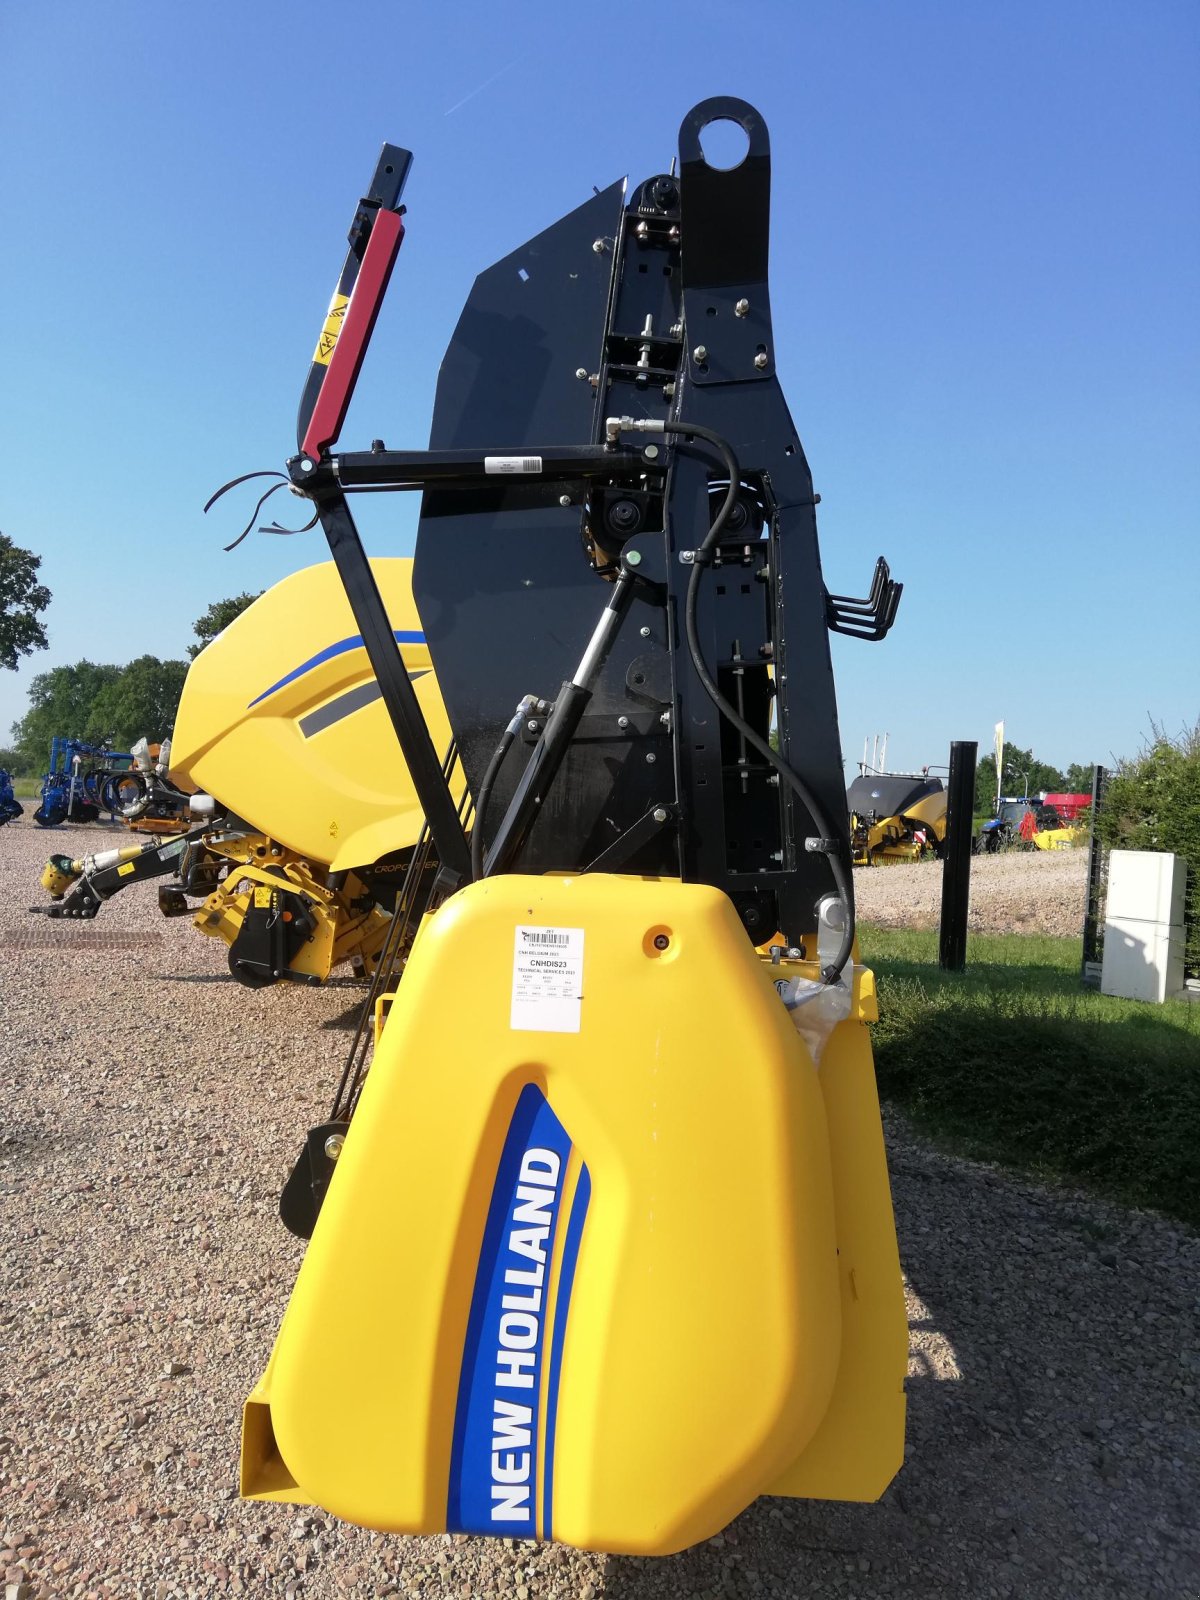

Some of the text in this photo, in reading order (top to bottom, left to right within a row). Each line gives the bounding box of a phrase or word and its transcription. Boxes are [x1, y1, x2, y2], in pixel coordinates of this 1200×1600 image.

[530, 959, 567, 968] CNHDIS23
[491, 1147, 561, 1521] NEW HOLLAND
